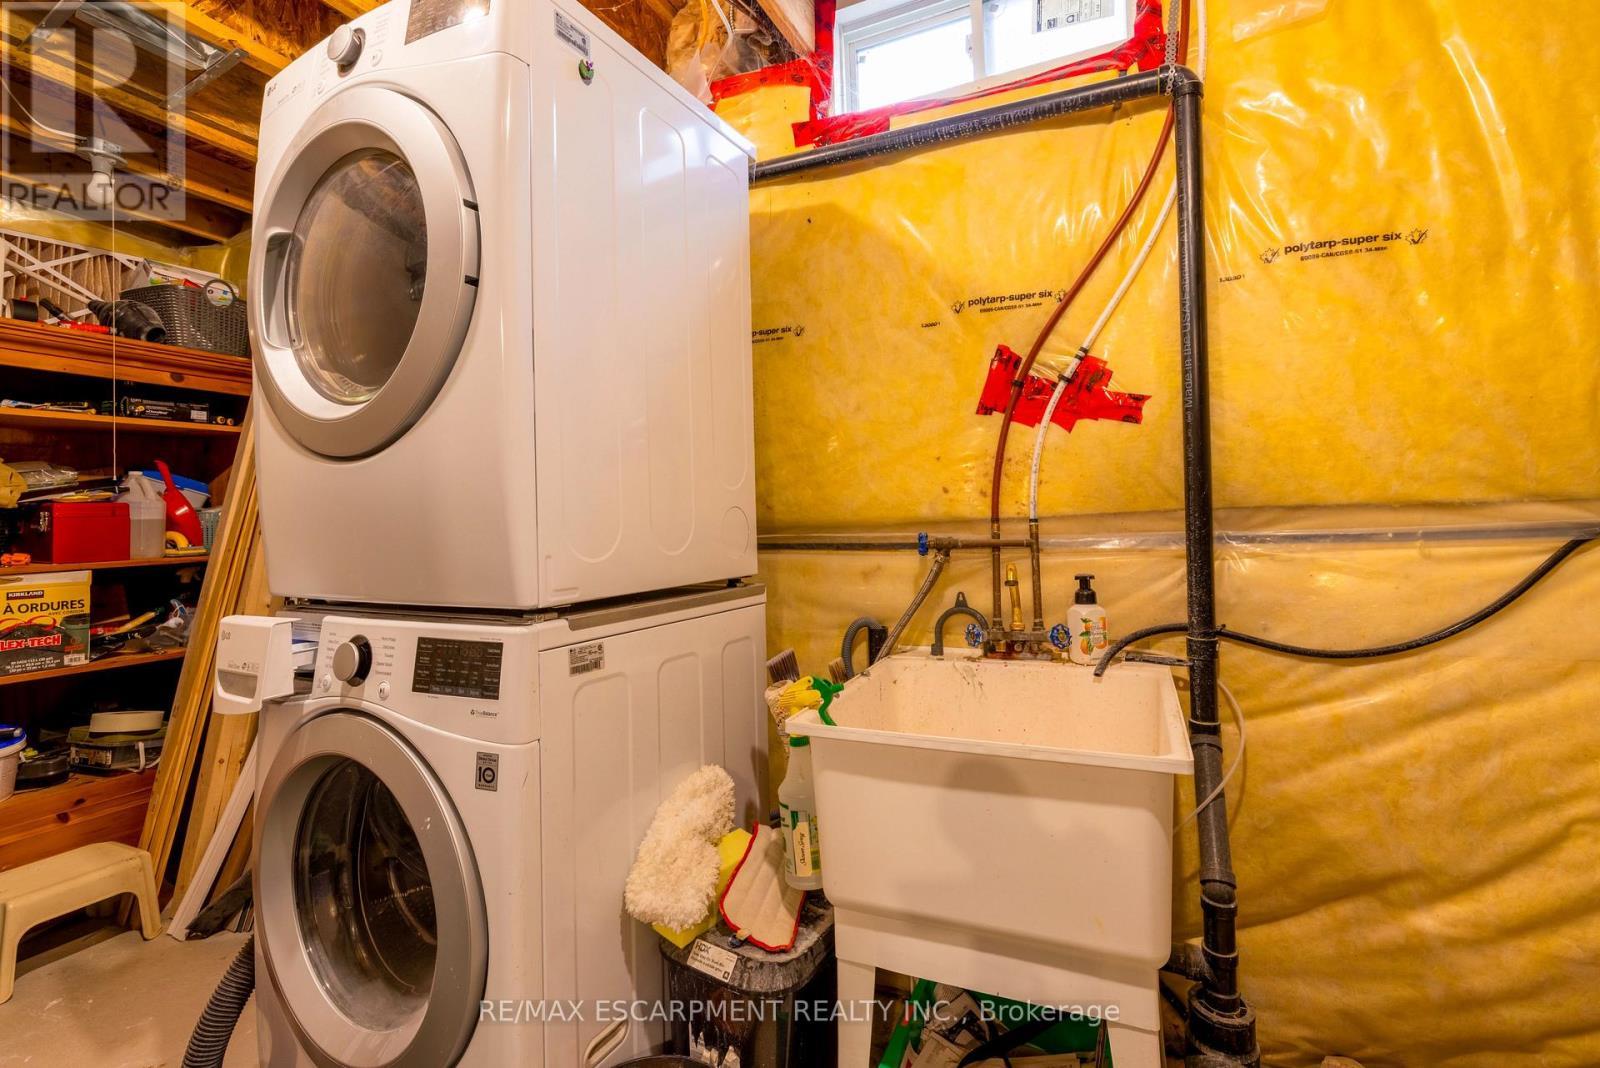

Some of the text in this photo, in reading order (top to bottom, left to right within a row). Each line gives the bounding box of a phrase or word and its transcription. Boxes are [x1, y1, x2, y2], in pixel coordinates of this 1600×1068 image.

[1284, 231, 1402, 255] polytarp-super six
[968, 289, 1053, 307] polytarp-super six
[781, 325, 792, 333] six
[1183, 336, 1192, 356] the
[1183, 359, 1192, 369] in
[1184, 373, 1193, 408] Made
[17, 599, 85, 614] ORDURES
[694, 941, 712, 954] HDX
